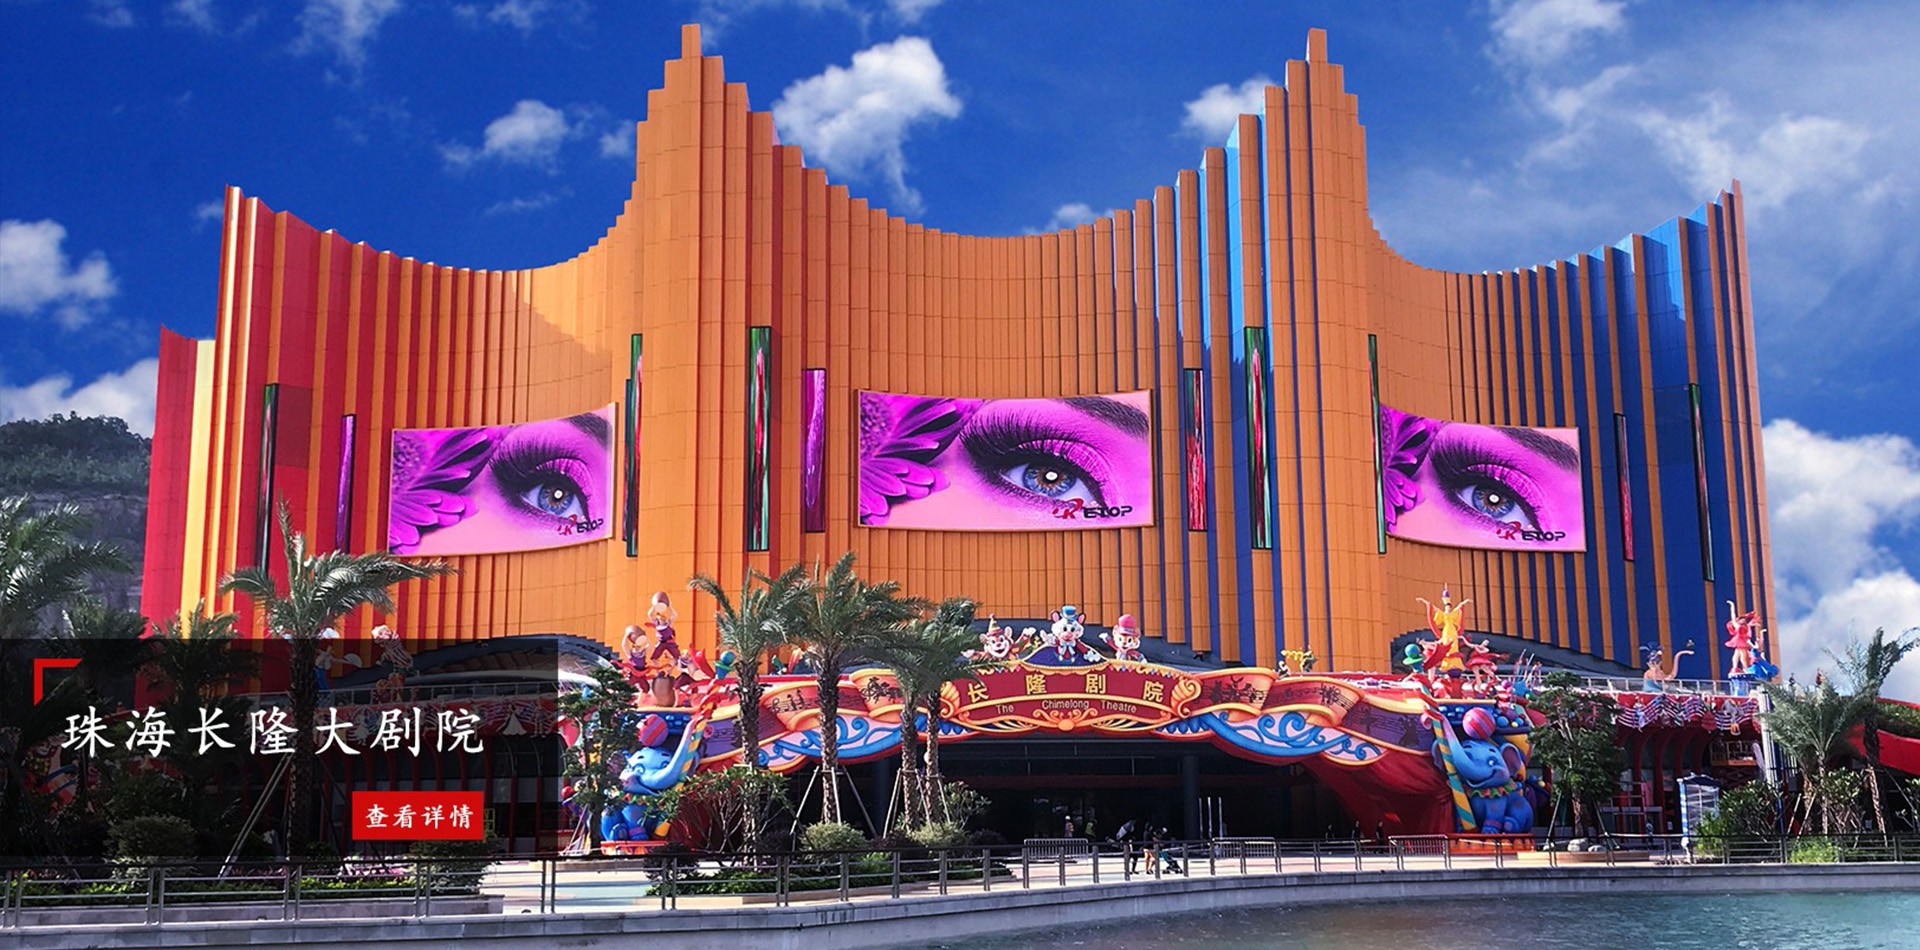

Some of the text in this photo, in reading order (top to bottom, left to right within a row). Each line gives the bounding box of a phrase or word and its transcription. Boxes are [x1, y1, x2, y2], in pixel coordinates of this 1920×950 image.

[968, 674, 1164, 702] 长隆剧院
[996, 699, 1137, 714] The Chimelong Theatre
